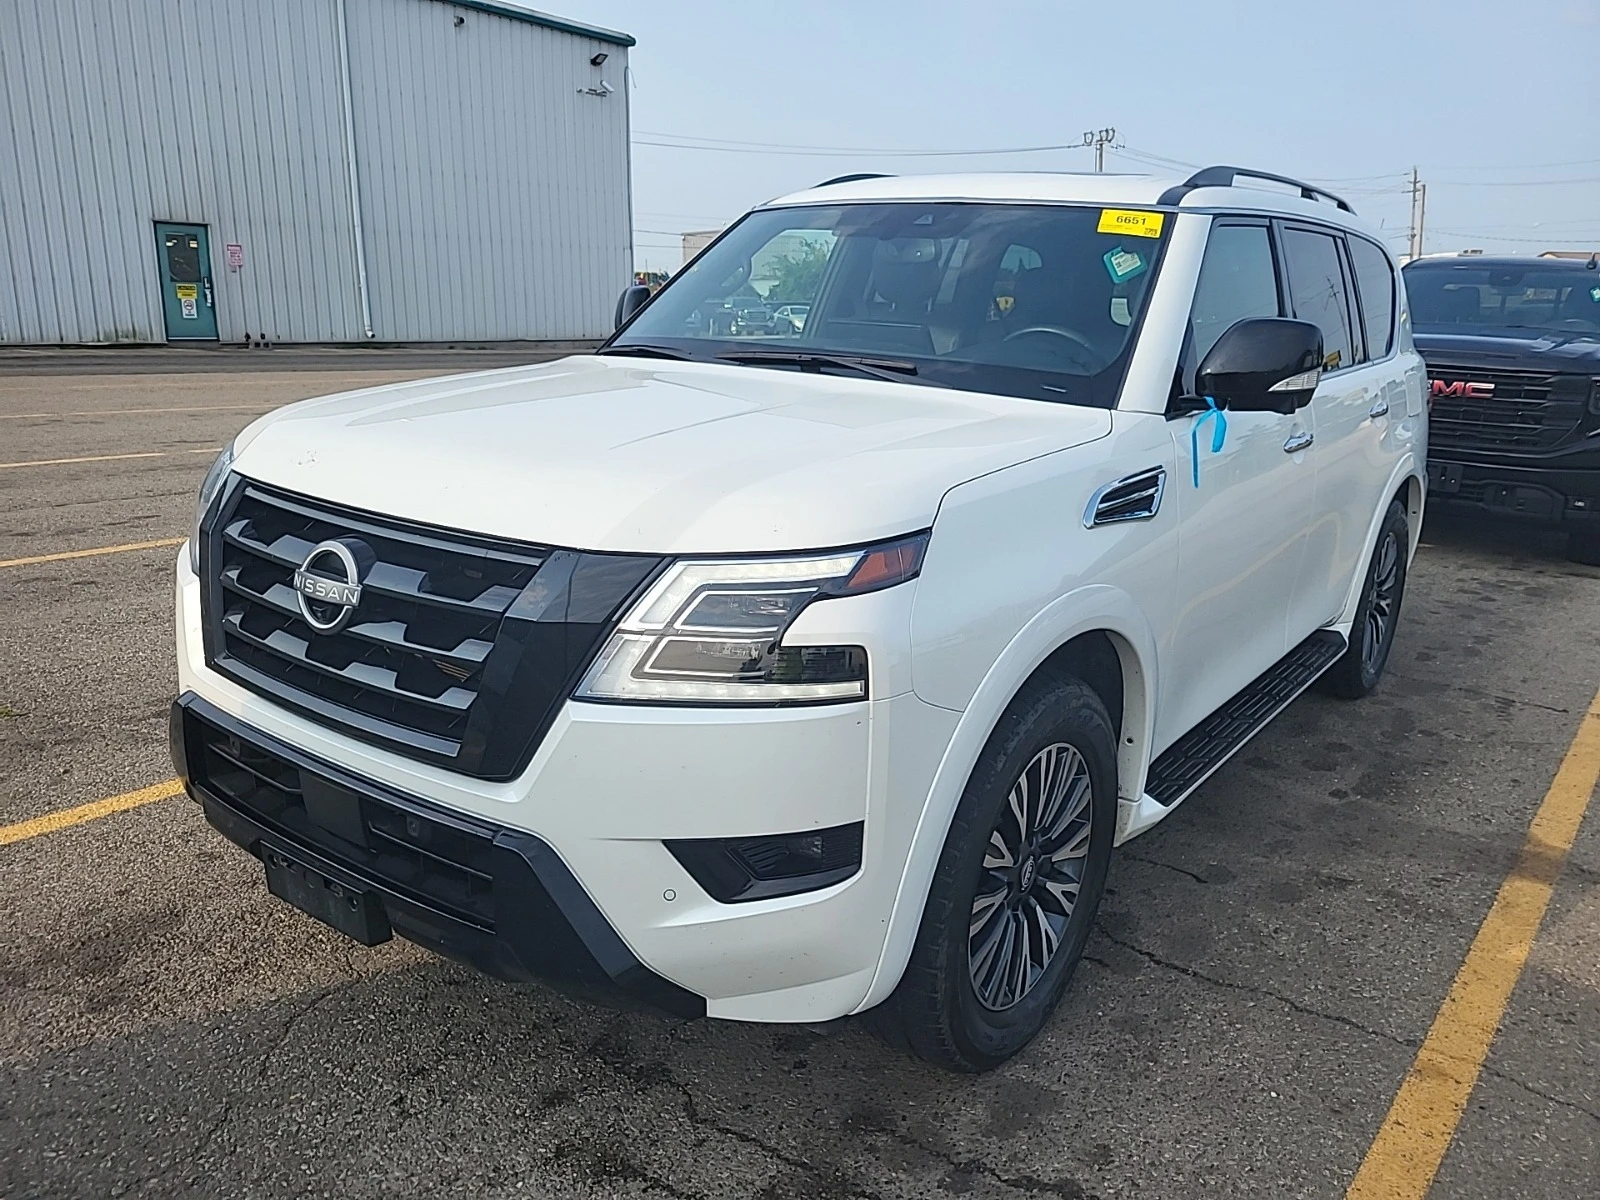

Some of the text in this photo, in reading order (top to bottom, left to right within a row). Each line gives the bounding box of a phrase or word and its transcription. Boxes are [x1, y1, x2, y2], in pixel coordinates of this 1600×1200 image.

[1116, 215, 1147, 226] 6651
[1427, 379, 1496, 398] MC
[293, 572, 359, 604] NISSAN
